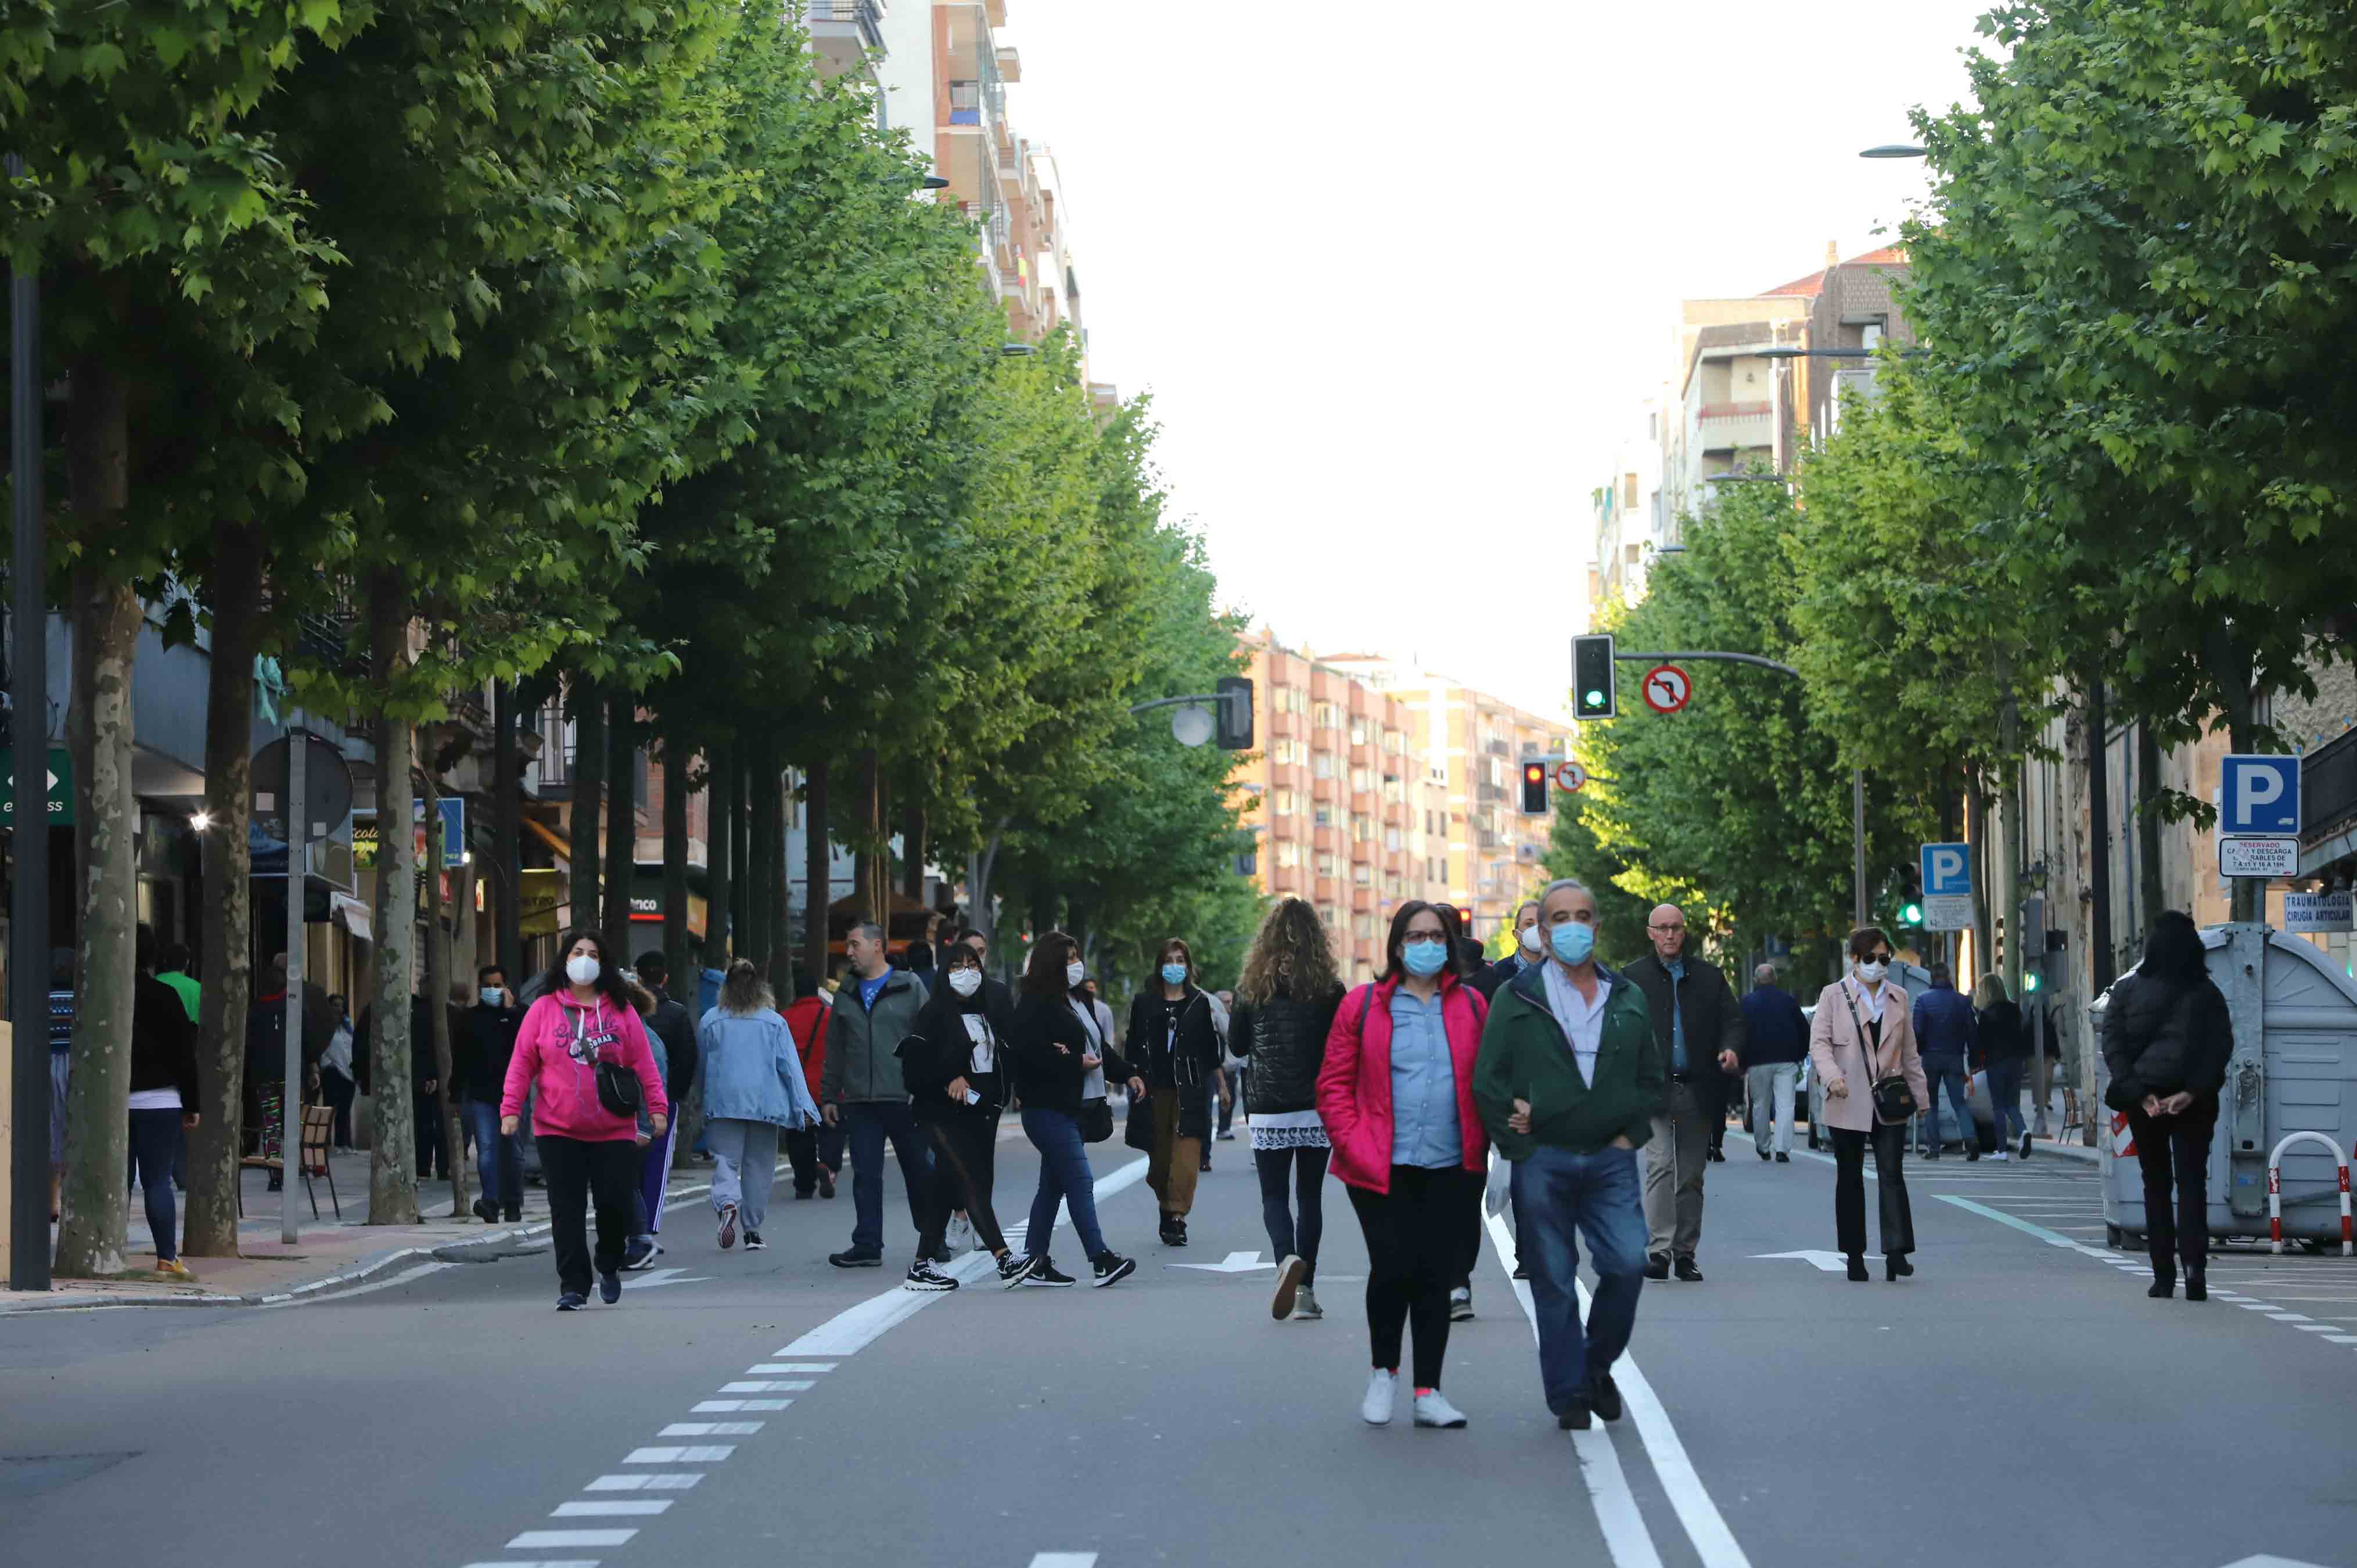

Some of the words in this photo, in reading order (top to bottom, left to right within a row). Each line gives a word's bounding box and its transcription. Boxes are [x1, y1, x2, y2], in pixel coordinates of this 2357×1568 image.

[2236, 764, 2284, 824] P
[1932, 850, 1963, 890] P
[2315, 910, 2351, 921] ARTICULAR
